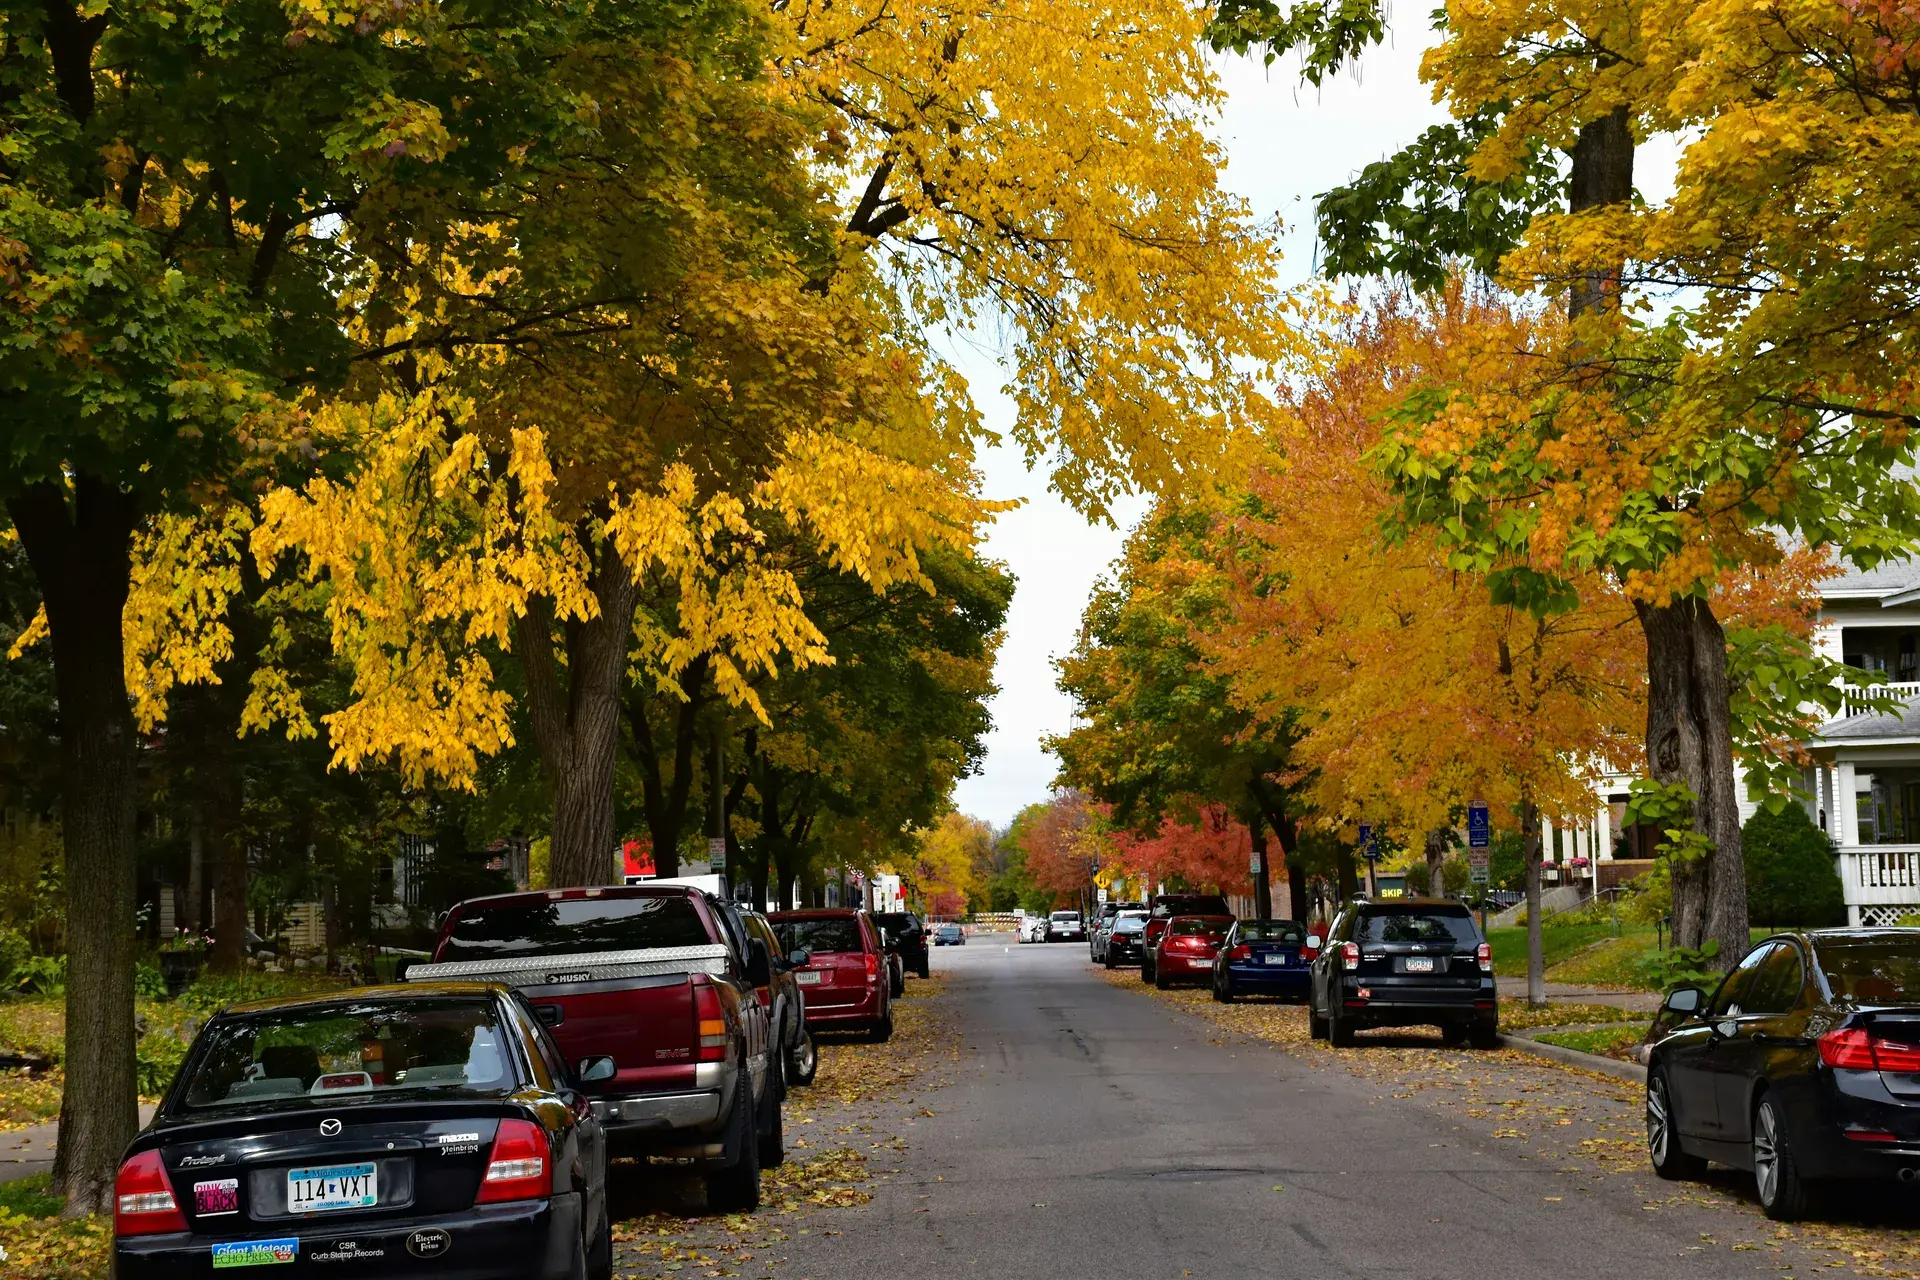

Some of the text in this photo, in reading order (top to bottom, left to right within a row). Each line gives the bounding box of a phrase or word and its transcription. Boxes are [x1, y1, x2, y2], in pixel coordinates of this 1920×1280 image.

[1381, 888, 1403, 898] SKIP
[559, 973, 590, 983] HUSKY
[655, 1047, 690, 1059] GMC
[441, 1144, 479, 1156] Steinbring
[312, 1167, 356, 1179] Minnesota
[196, 1183, 221, 1197] PINK
[293, 1174, 372, 1203] 114 VXT
[197, 1194, 236, 1212] BLACK
[415, 1234, 443, 1243] Electric
[217, 1244, 294, 1255] Giant Meteor
[339, 1241, 356, 1250] CSR
[214, 1251, 274, 1265] ECHO PRESS
[311, 1248, 384, 1261] Curb Stomp Records
